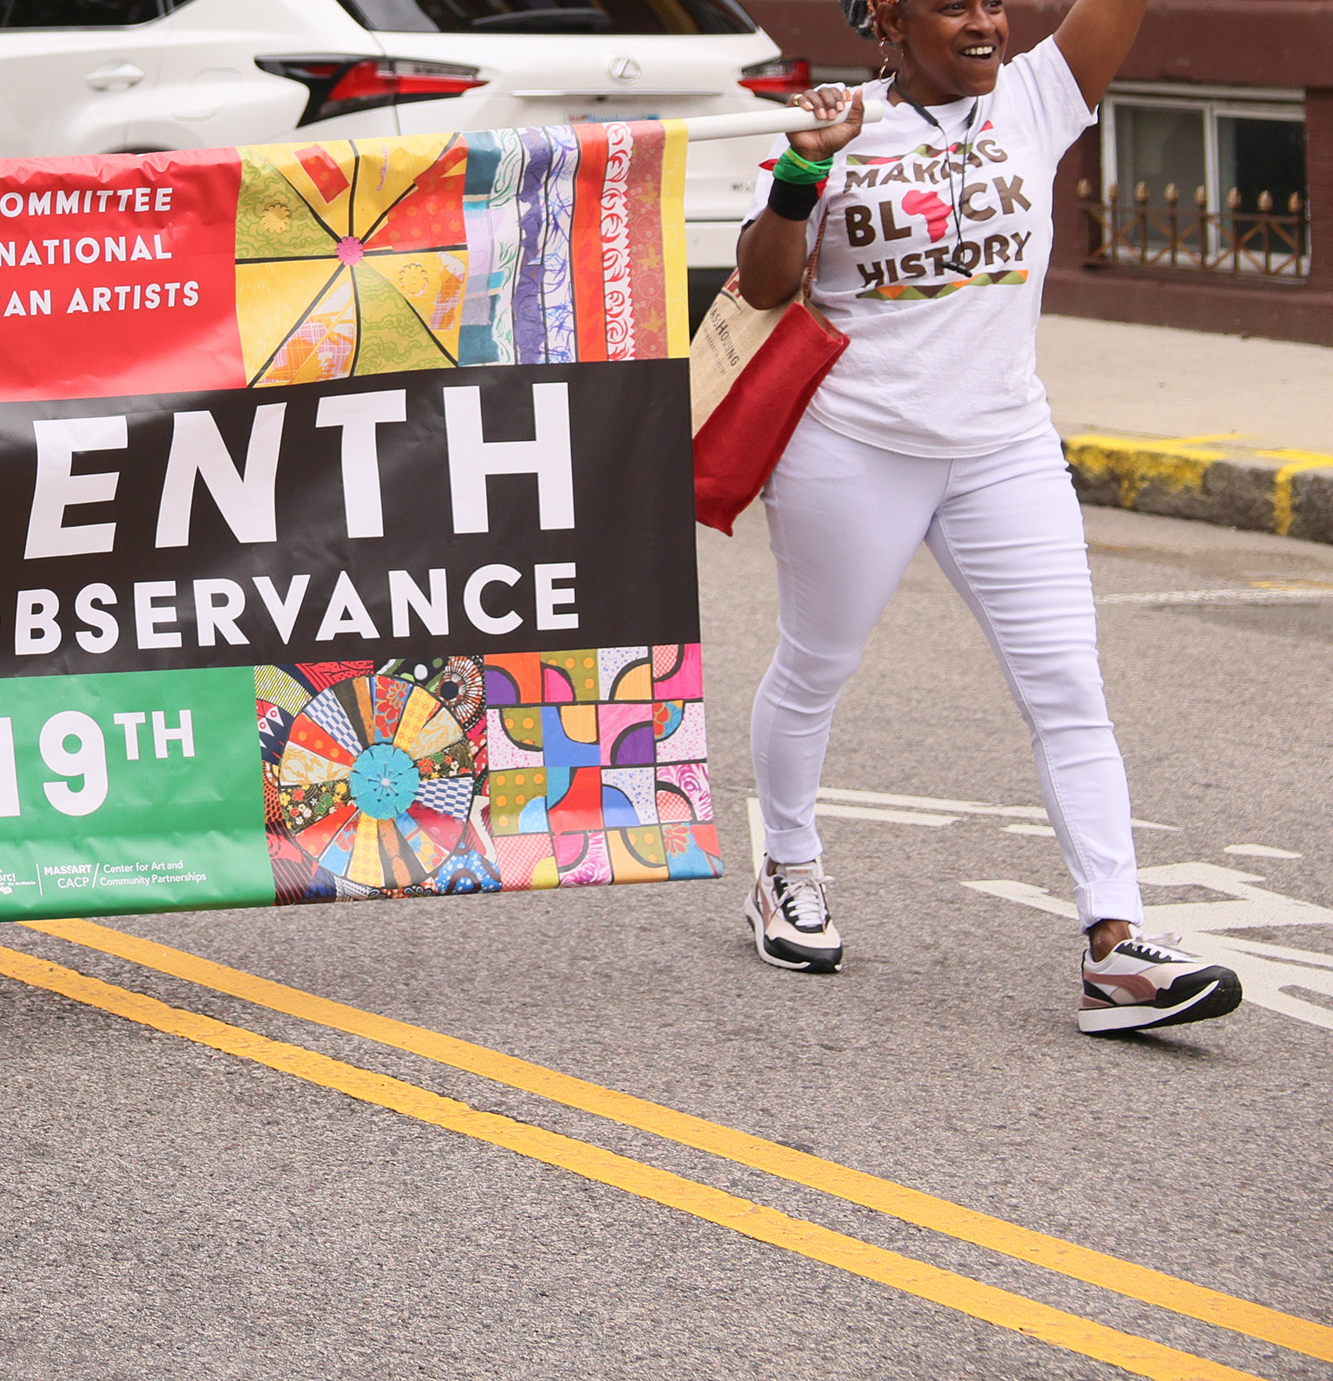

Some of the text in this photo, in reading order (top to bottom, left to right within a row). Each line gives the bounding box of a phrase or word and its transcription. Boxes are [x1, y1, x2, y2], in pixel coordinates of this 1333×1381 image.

[857, 231, 1032, 289] HISTORY
[67, 281, 198, 313] ARTISTS
[104, 860, 183, 873] Center for Art and
[58, 877, 89, 888] CACP
[100, 873, 206, 886] Community Partnerships
